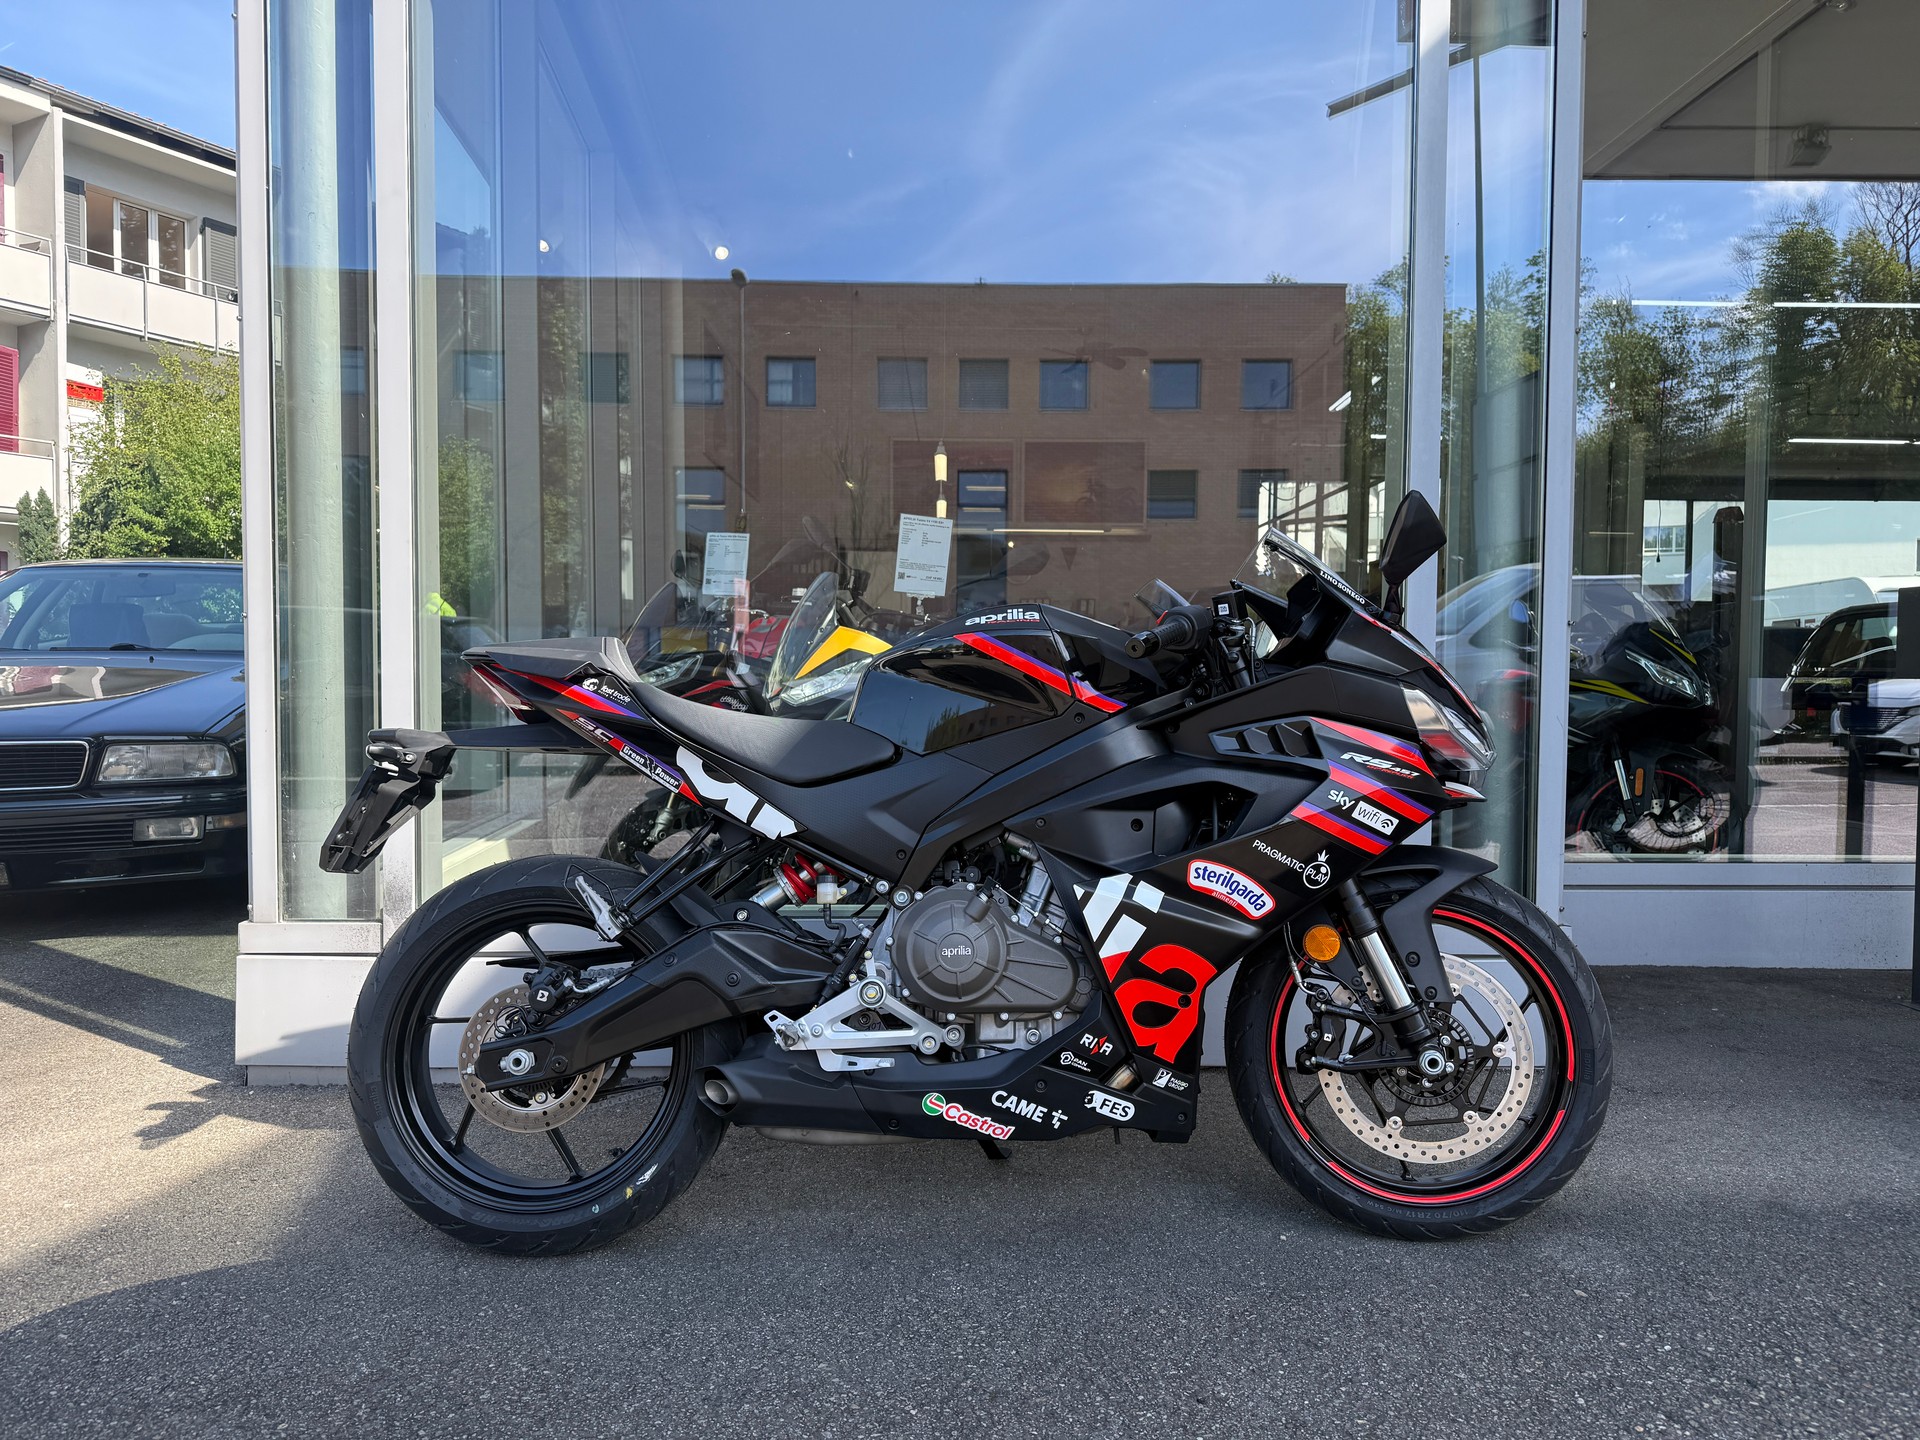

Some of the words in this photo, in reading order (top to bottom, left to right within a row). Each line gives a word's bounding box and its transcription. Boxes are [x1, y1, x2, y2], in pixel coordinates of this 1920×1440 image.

[1320, 571, 1338, 586] LINO
[1337, 582, 1365, 605] SONEGO
[965, 608, 1040, 626] aprilia
[622, 745, 646, 765] Green
[655, 766, 679, 787] Power
[1328, 789, 1356, 810] sky
[1357, 806, 1382, 825] wifi
[1252, 839, 1306, 873] PRAGMATIC
[1305, 867, 1328, 884] PLAY
[1193, 865, 1267, 912] sterilgarda
[1211, 890, 1239, 908] alimenti
[941, 945, 972, 958] aprilia
[943, 1104, 1015, 1139] Castrol
[991, 1090, 1048, 1123] CAME
[1099, 1098, 1132, 1118] FES
